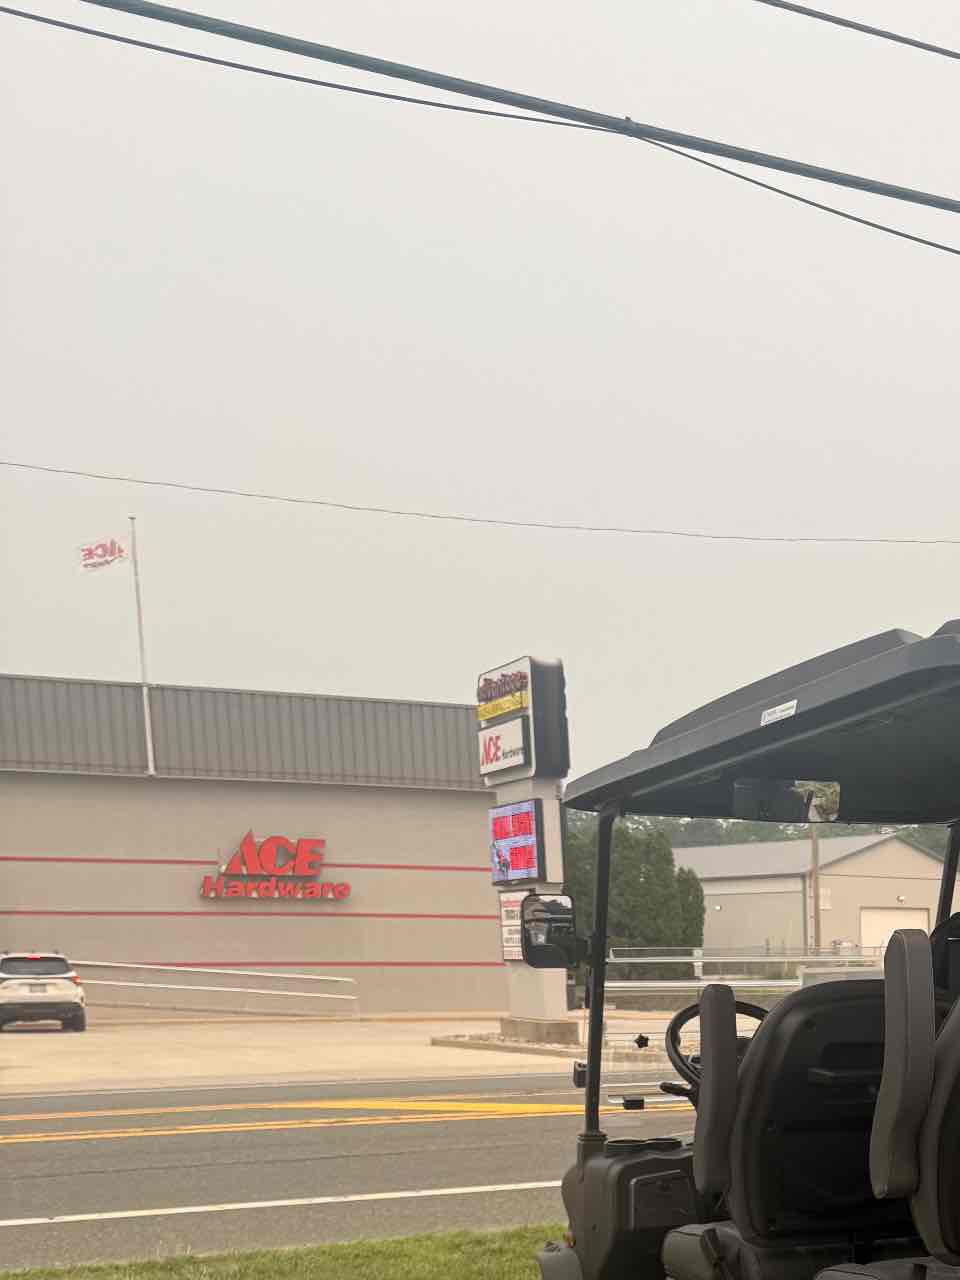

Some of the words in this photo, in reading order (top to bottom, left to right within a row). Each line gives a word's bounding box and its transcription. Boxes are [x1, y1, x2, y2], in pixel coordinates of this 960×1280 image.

[480, 735, 502, 767] ACE
[220, 829, 326, 876] ACE
[202, 875, 350, 900] Hardware
